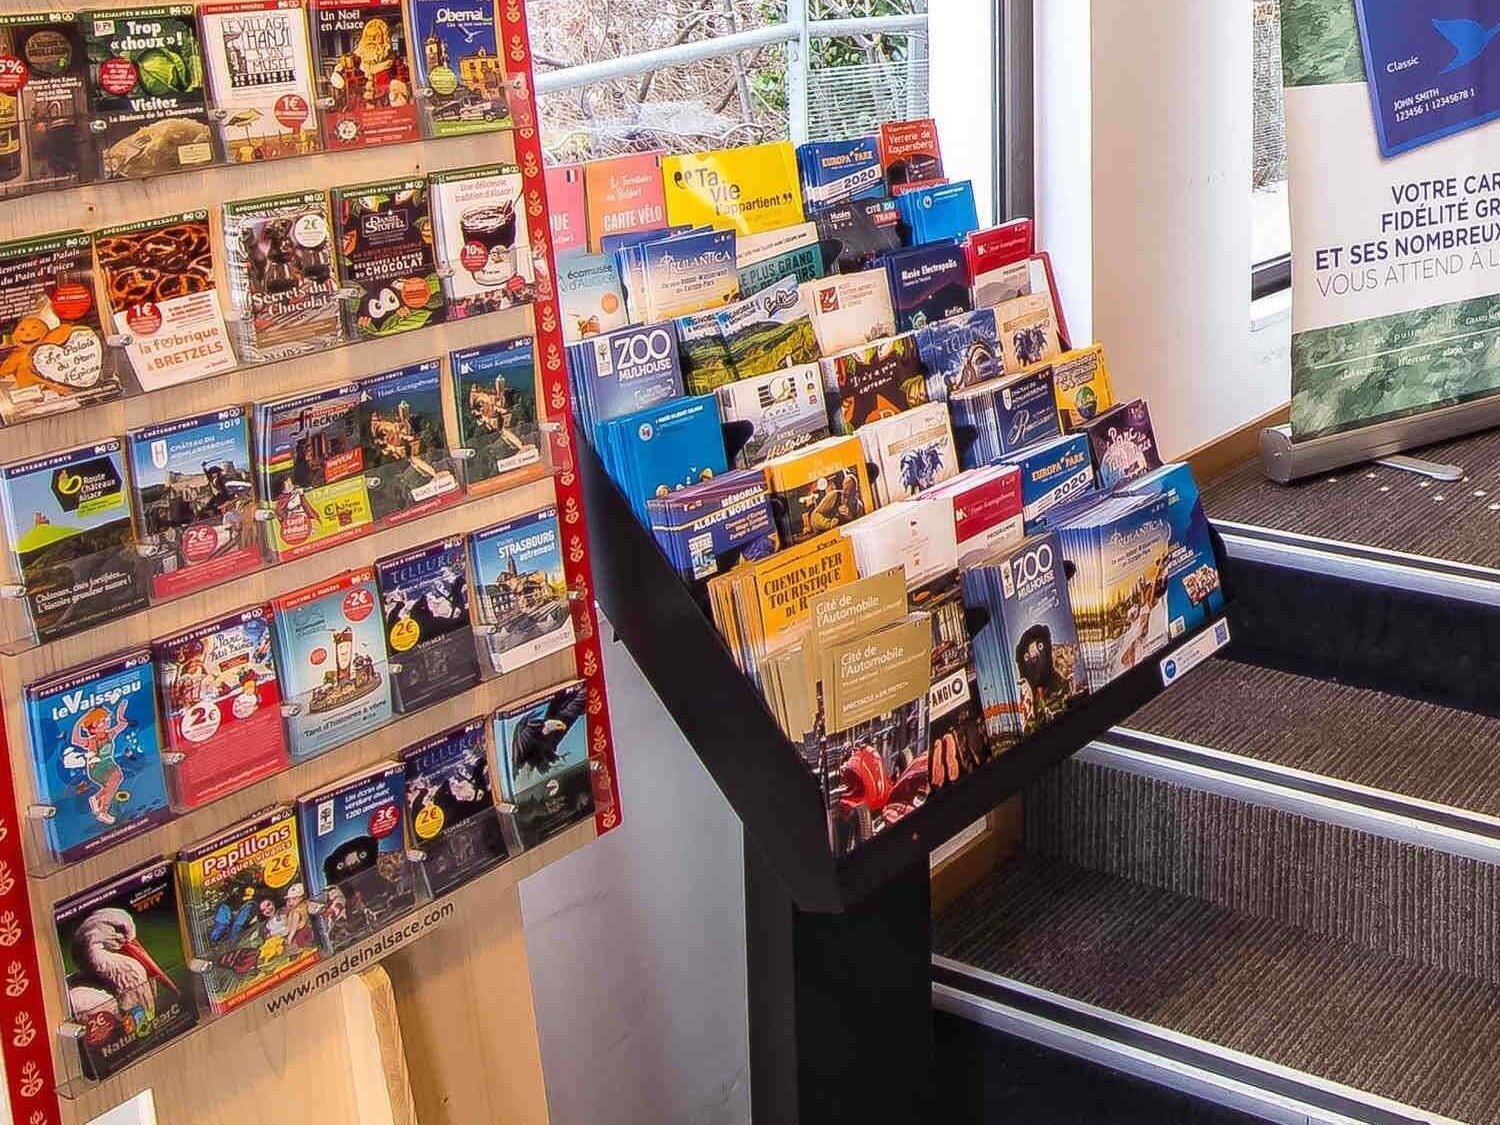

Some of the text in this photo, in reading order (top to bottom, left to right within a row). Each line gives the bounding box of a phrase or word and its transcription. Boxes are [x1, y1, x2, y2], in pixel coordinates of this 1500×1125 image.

[238, 17, 288, 32] VILLAGE
[321, 9, 360, 21] Un Noël
[126, 21, 161, 37] Trop
[321, 20, 364, 32] en Alsace
[1386, 55, 1420, 73] Classic
[130, 97, 178, 112] Visitez
[283, 98, 300, 110] 1€
[1394, 87, 1439, 111] JOHN SMITH
[1396, 104, 1423, 122] 123456
[1432, 90, 1469, 109] 12345678
[822, 155, 851, 167] EUROPA
[697, 168, 719, 187] Ta
[843, 169, 876, 190] 2020
[710, 181, 741, 202] vie
[1391, 178, 1457, 205] VOTRE
[303, 219, 318, 230] 2€
[604, 204, 662, 231] CARTE VÉLO
[1380, 197, 1469, 233] FIDÉLITÉ
[751, 265, 775, 281] PLUS
[778, 250, 813, 273] GRAND
[1315, 248, 1343, 271] ET
[1350, 241, 1389, 265] SES
[15, 271, 36, 283] Pain
[366, 258, 422, 276] CHOCOLAT
[1316, 269, 1378, 298] VOUS
[1384, 254, 1464, 286] ATTEND
[1470, 247, 1484, 271] À
[252, 285, 306, 305] Secrets
[133, 303, 152, 316] 1€
[268, 296, 327, 317] Chocolat
[944, 306, 963, 316] Enfin
[155, 341, 224, 368] BRETZELS
[615, 329, 672, 368] ZOO
[619, 359, 672, 380] MULHOUSE
[721, 485, 763, 506] MÉMORIAL
[1054, 472, 1087, 499] 2020
[499, 531, 555, 558] STRASBOURG
[764, 569, 805, 595] CHEMIN
[821, 553, 842, 570] FER
[1013, 544, 1053, 589] ZOO
[770, 568, 841, 609] TOURISTIQUE
[816, 595, 853, 615] Cité de
[816, 595, 879, 628] l'Automobile
[841, 646, 877, 666] Cité de
[841, 647, 904, 678] l'Automobile
[376, 806, 395, 821] 3€
[420, 807, 439, 823] 2€
[204, 825, 290, 875] Papillons
[271, 855, 291, 873] 2€
